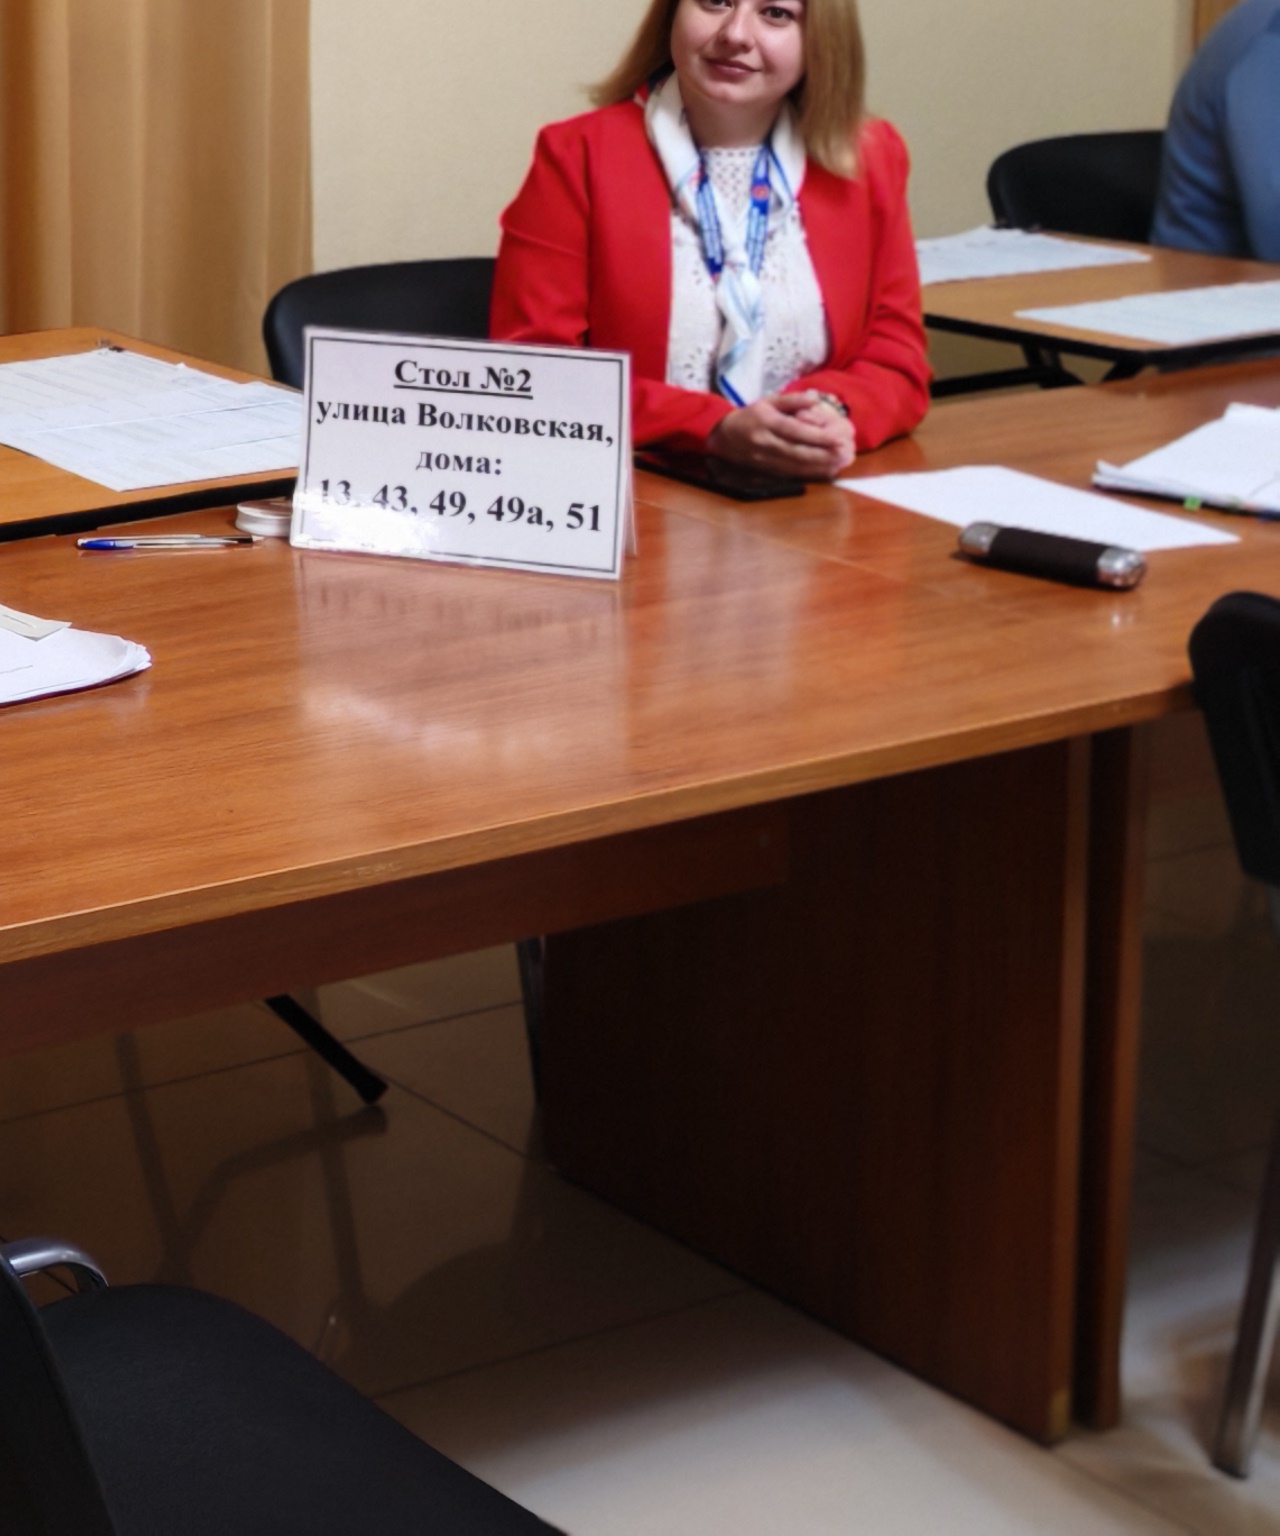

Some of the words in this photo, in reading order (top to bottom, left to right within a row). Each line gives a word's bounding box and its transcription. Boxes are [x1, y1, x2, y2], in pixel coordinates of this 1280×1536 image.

[394, 359, 470, 390] Стол
[480, 366, 533, 393] №2
[316, 400, 407, 425] улица
[417, 402, 614, 447] Волковская,
[415, 450, 502, 476] дома:
[372, 484, 418, 515] 43,
[429, 490, 476, 524] 49,
[487, 495, 555, 532] 49а,
[565, 503, 601, 531] 51
